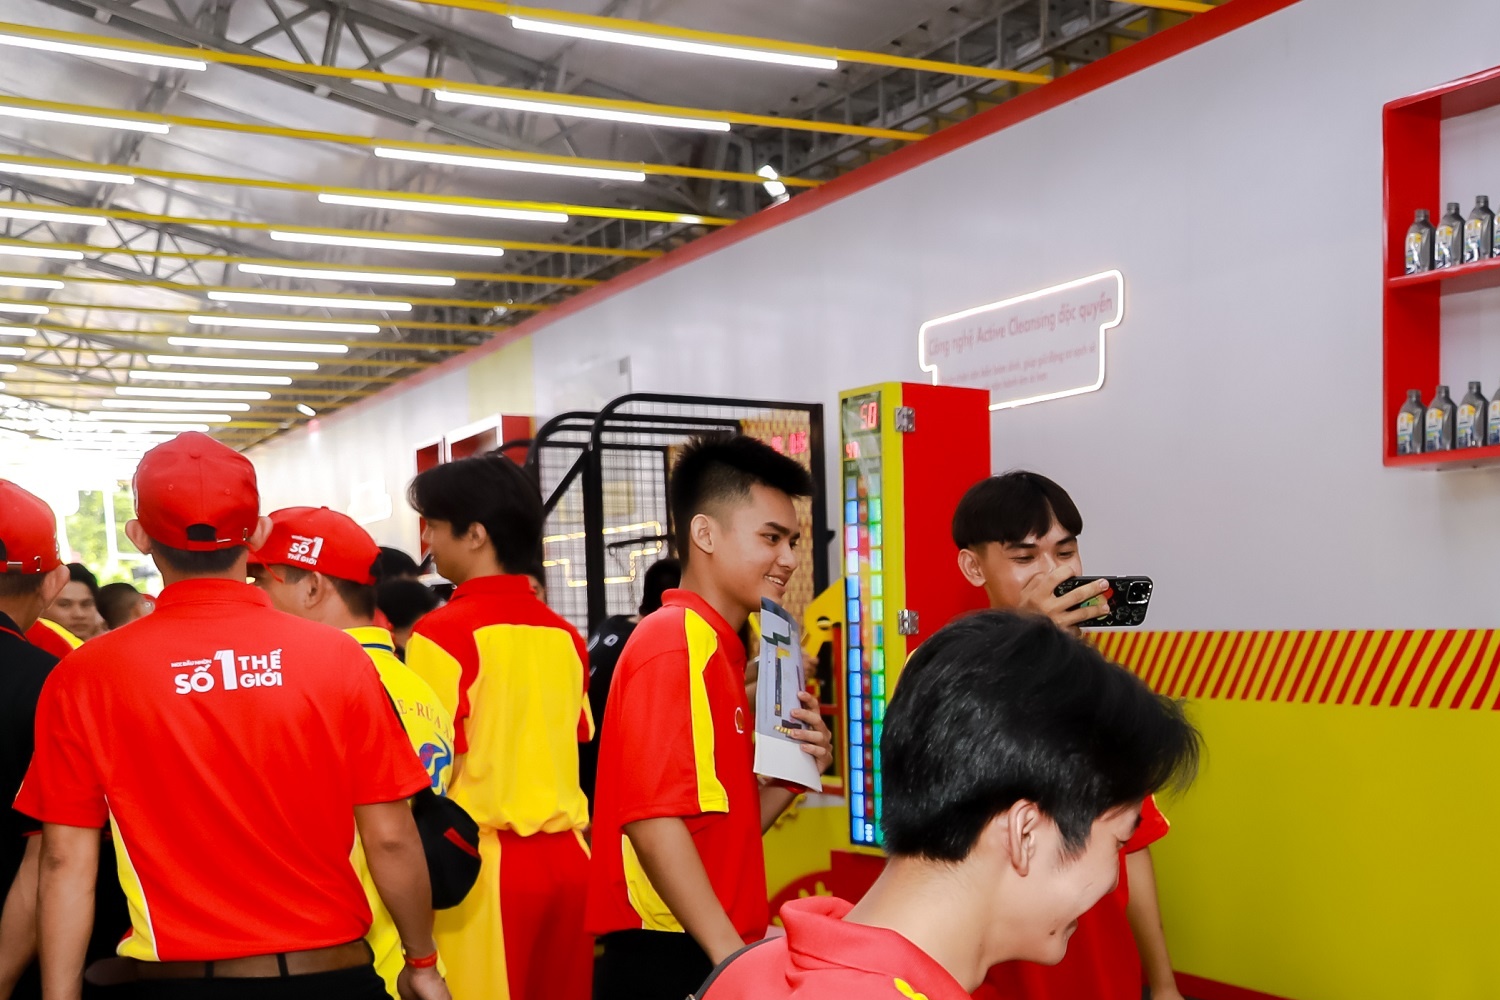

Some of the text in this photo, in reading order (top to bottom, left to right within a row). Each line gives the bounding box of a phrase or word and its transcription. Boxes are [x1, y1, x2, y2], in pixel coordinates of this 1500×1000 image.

[1009, 312, 1055, 336] Cleansing
[311, 536, 324, 558] 1
[174, 648, 282, 695] SỐ 1 THẾ
[239, 668, 283, 688] GIỚI
